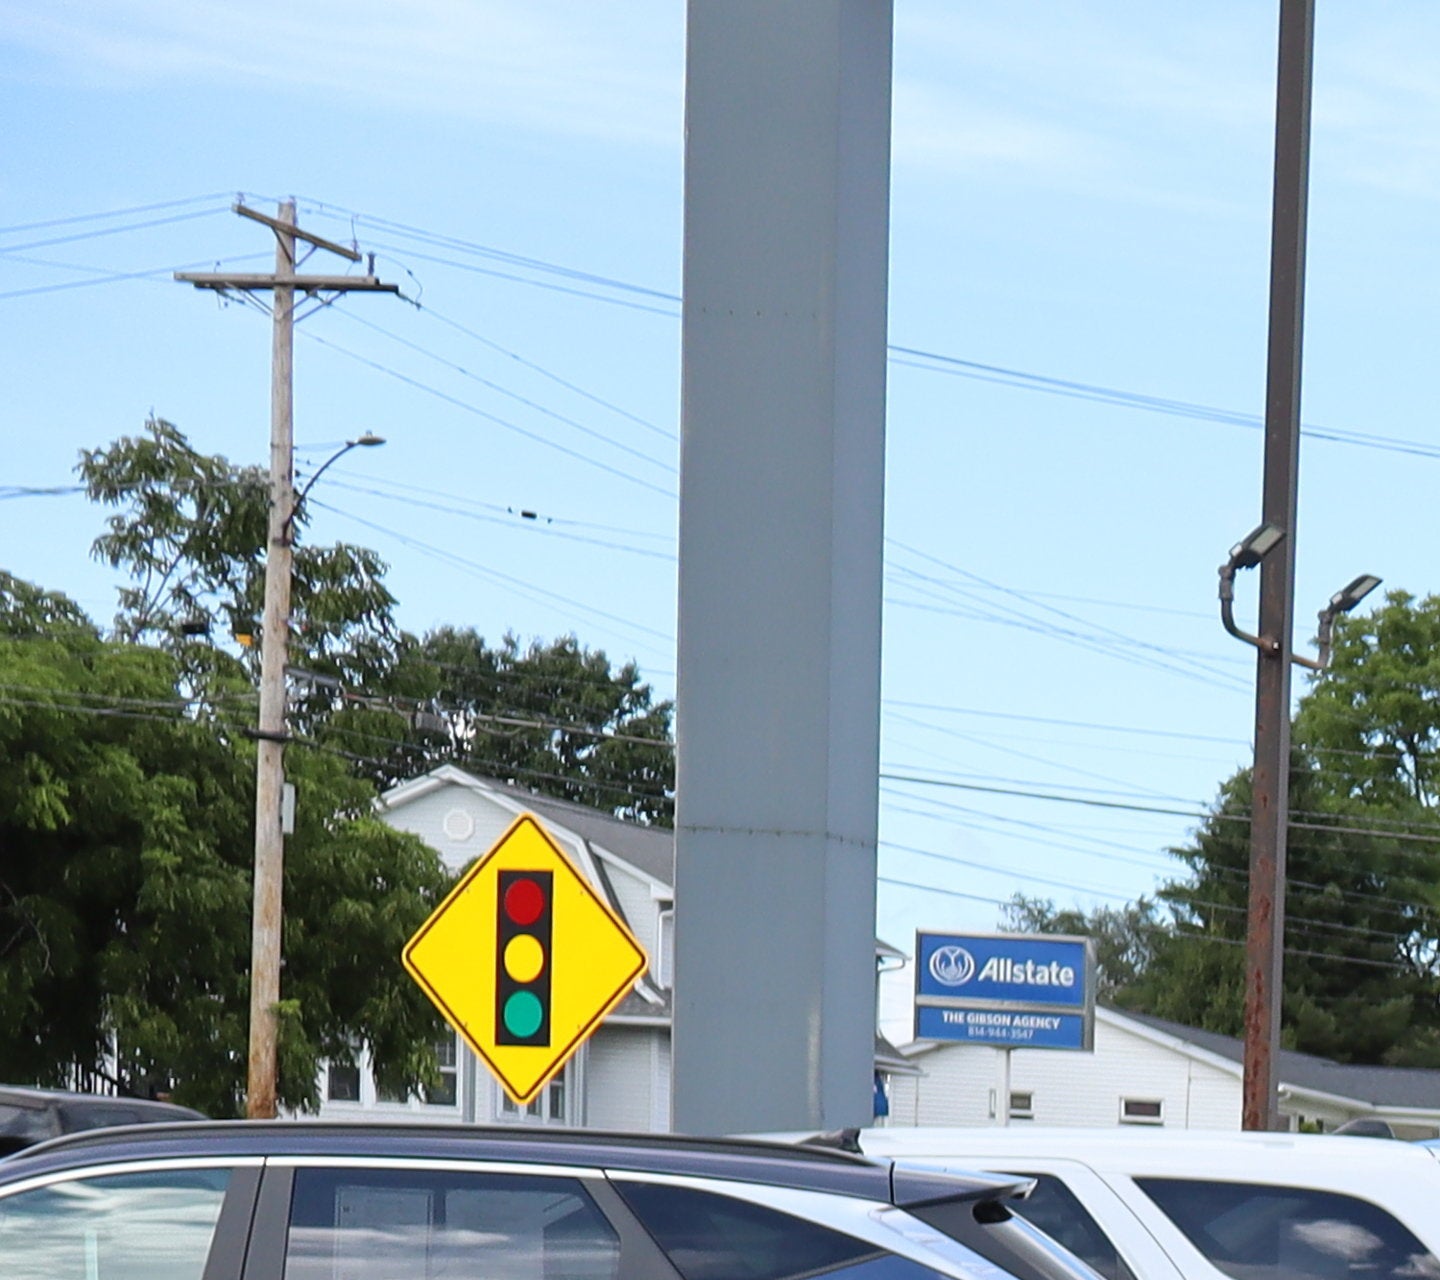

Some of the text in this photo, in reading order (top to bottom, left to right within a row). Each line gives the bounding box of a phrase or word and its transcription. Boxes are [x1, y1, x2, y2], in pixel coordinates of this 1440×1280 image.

[978, 957, 1075, 987] Allstate
[942, 1011, 1061, 1030] THE GIBSON AGENCY
